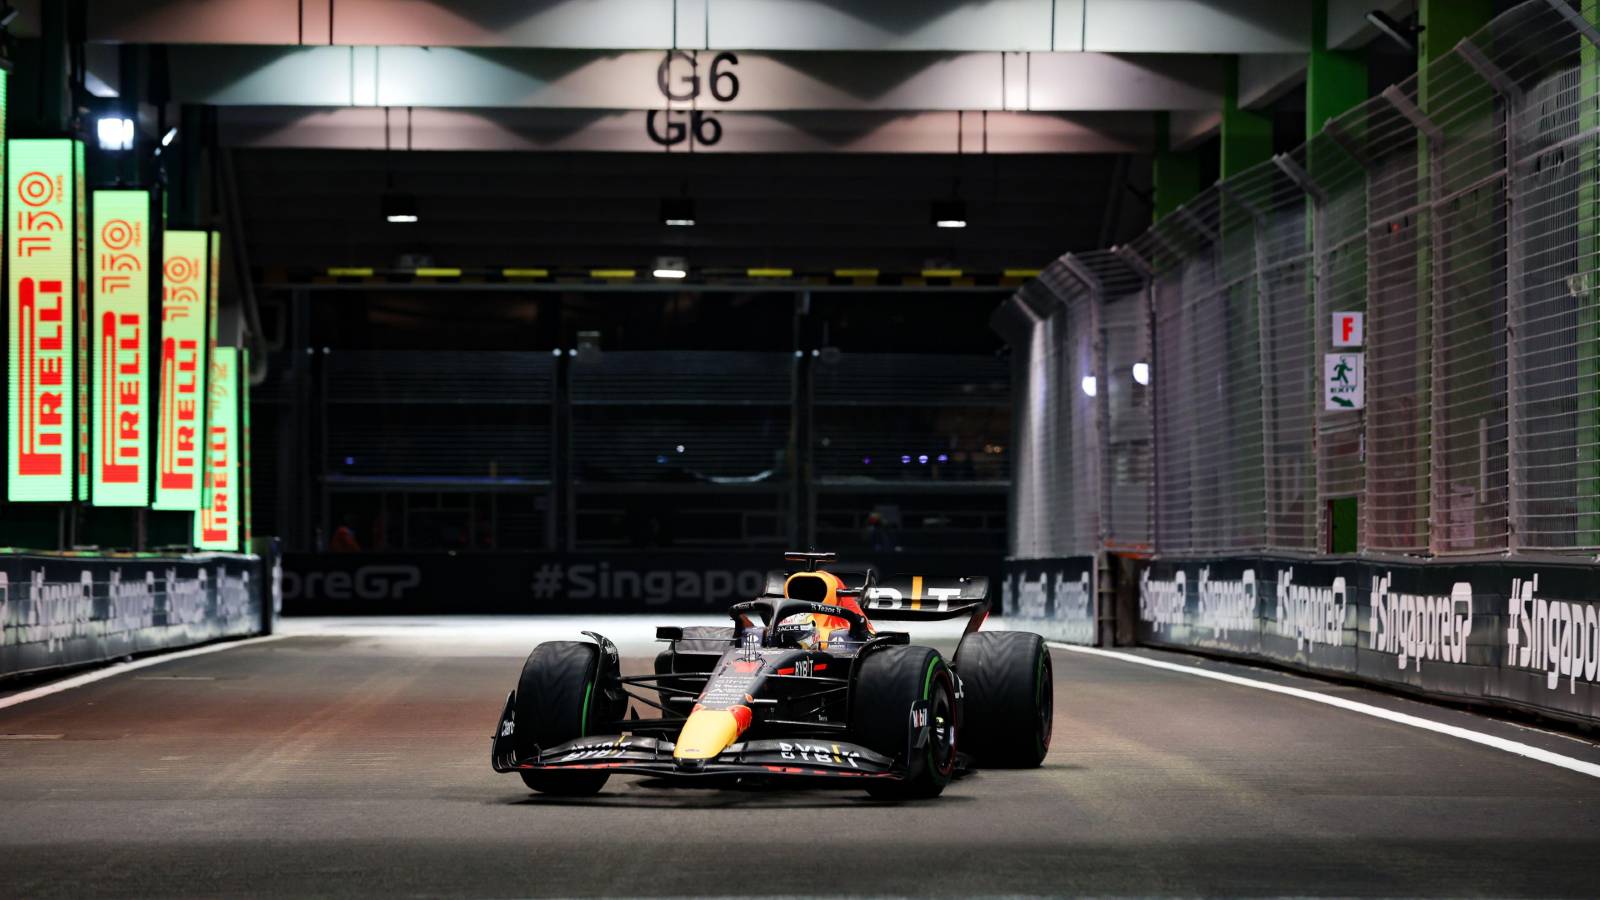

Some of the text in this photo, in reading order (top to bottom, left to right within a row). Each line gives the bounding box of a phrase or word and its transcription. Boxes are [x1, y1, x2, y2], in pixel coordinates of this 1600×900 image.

[646, 110, 723, 146] G6
[657, 52, 740, 102] G6
[18, 171, 64, 475] PIRELLI 150
[1342, 317, 1354, 342] F
[102, 311, 140, 483] PIRELLI
[161, 337, 198, 489] PIRELLI
[1329, 386, 1357, 394] EXIT
[1370, 571, 1473, 673] #SingaporeGP
[1507, 573, 1600, 694] #Singapo
